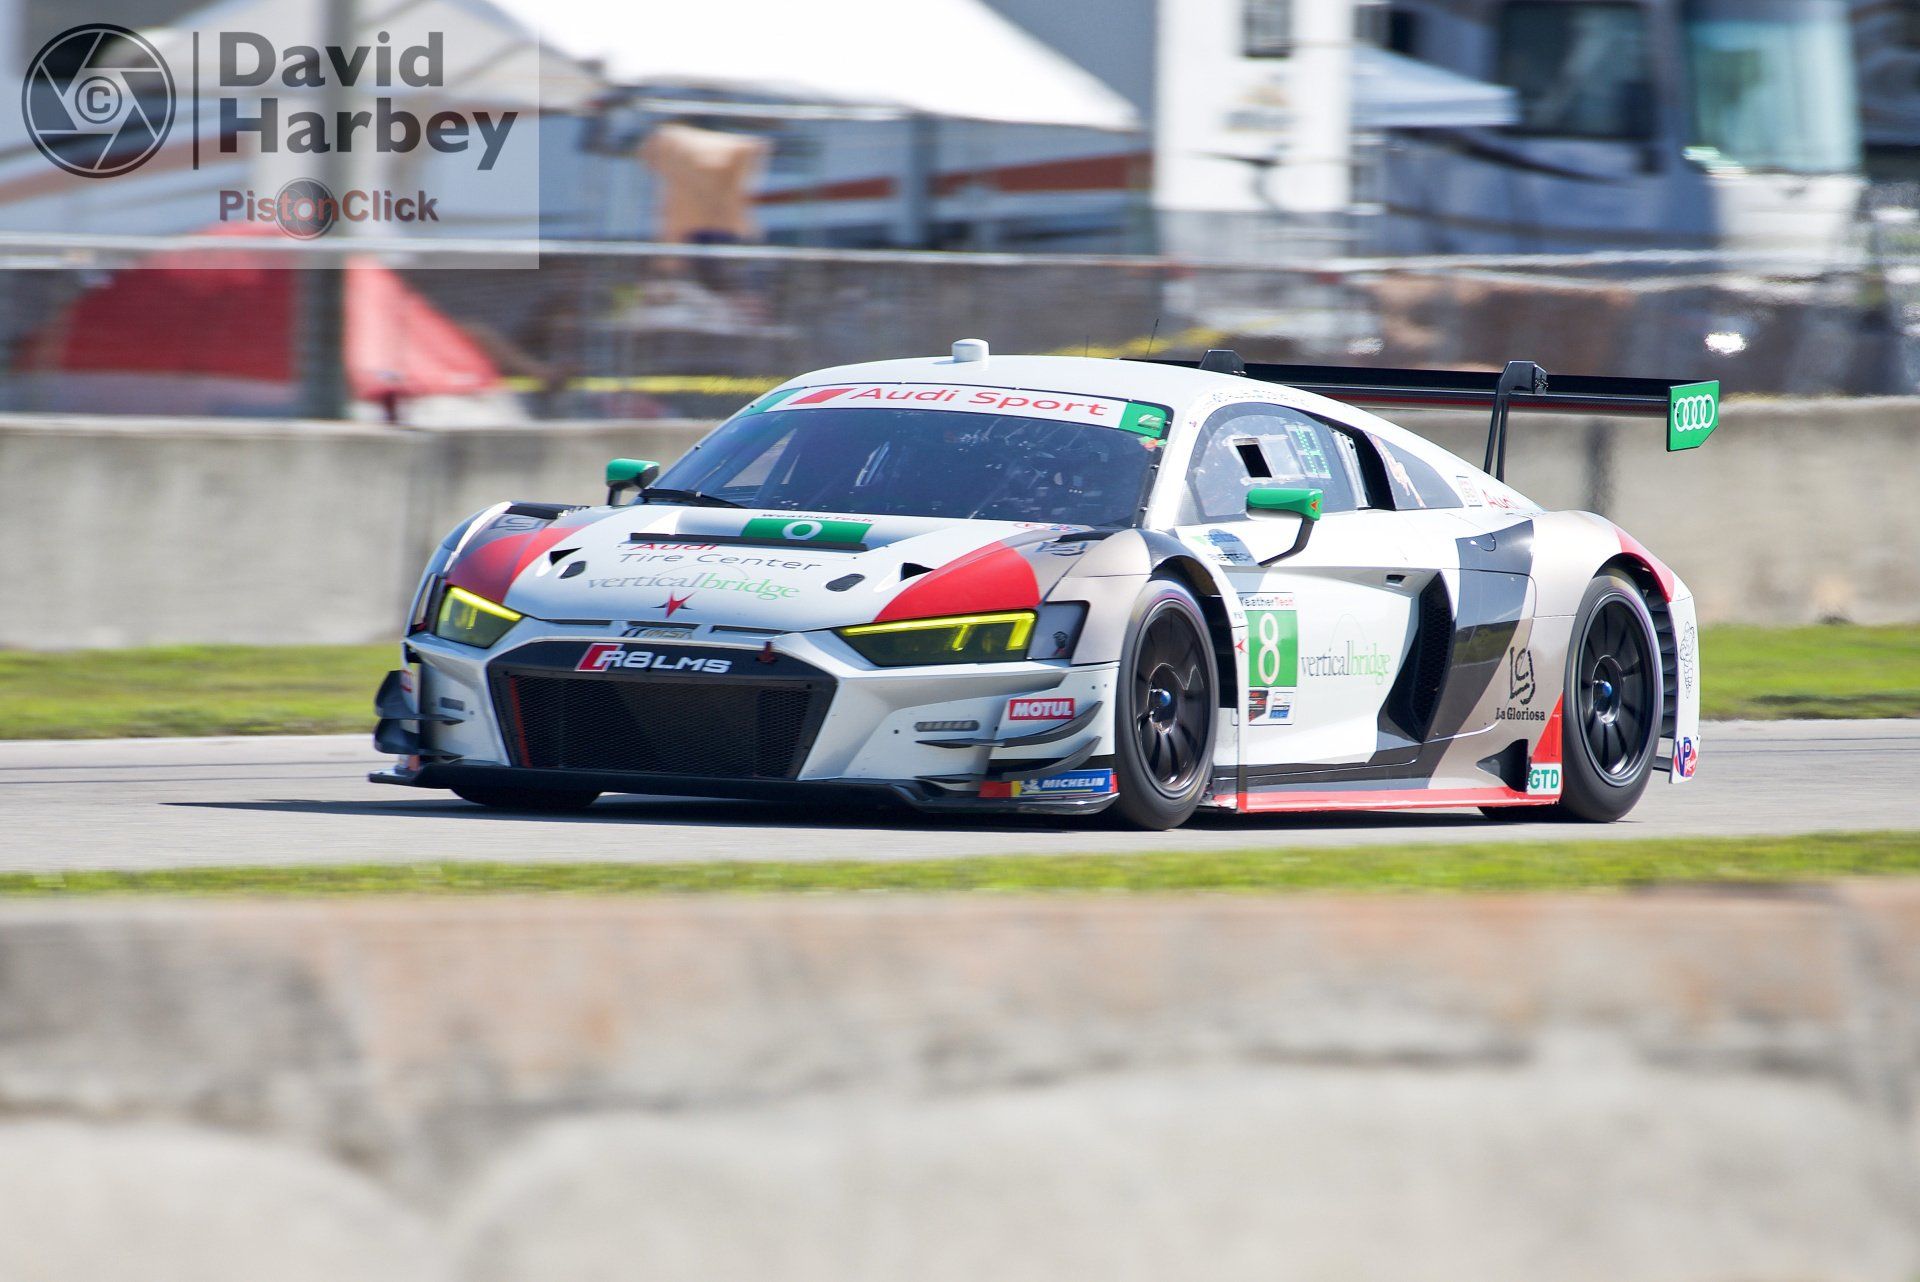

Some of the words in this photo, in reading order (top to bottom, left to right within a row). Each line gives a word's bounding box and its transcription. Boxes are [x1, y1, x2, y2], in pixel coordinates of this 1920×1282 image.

[849, 388, 960, 403] Audi
[968, 390, 1109, 416] Sport
[620, 553, 683, 563] Tire
[697, 553, 823, 570] Center
[588, 572, 800, 601] verticalbridge
[1258, 612, 1280, 685] 8
[1301, 640, 1391, 685] verticalbridge
[1011, 701, 1073, 717] MOTUL
[1495, 708, 1505, 720] La
[1506, 708, 1546, 721] Gloriosa
[1041, 777, 1106, 788] MICHELIN
[1530, 769, 1559, 789] GTD
